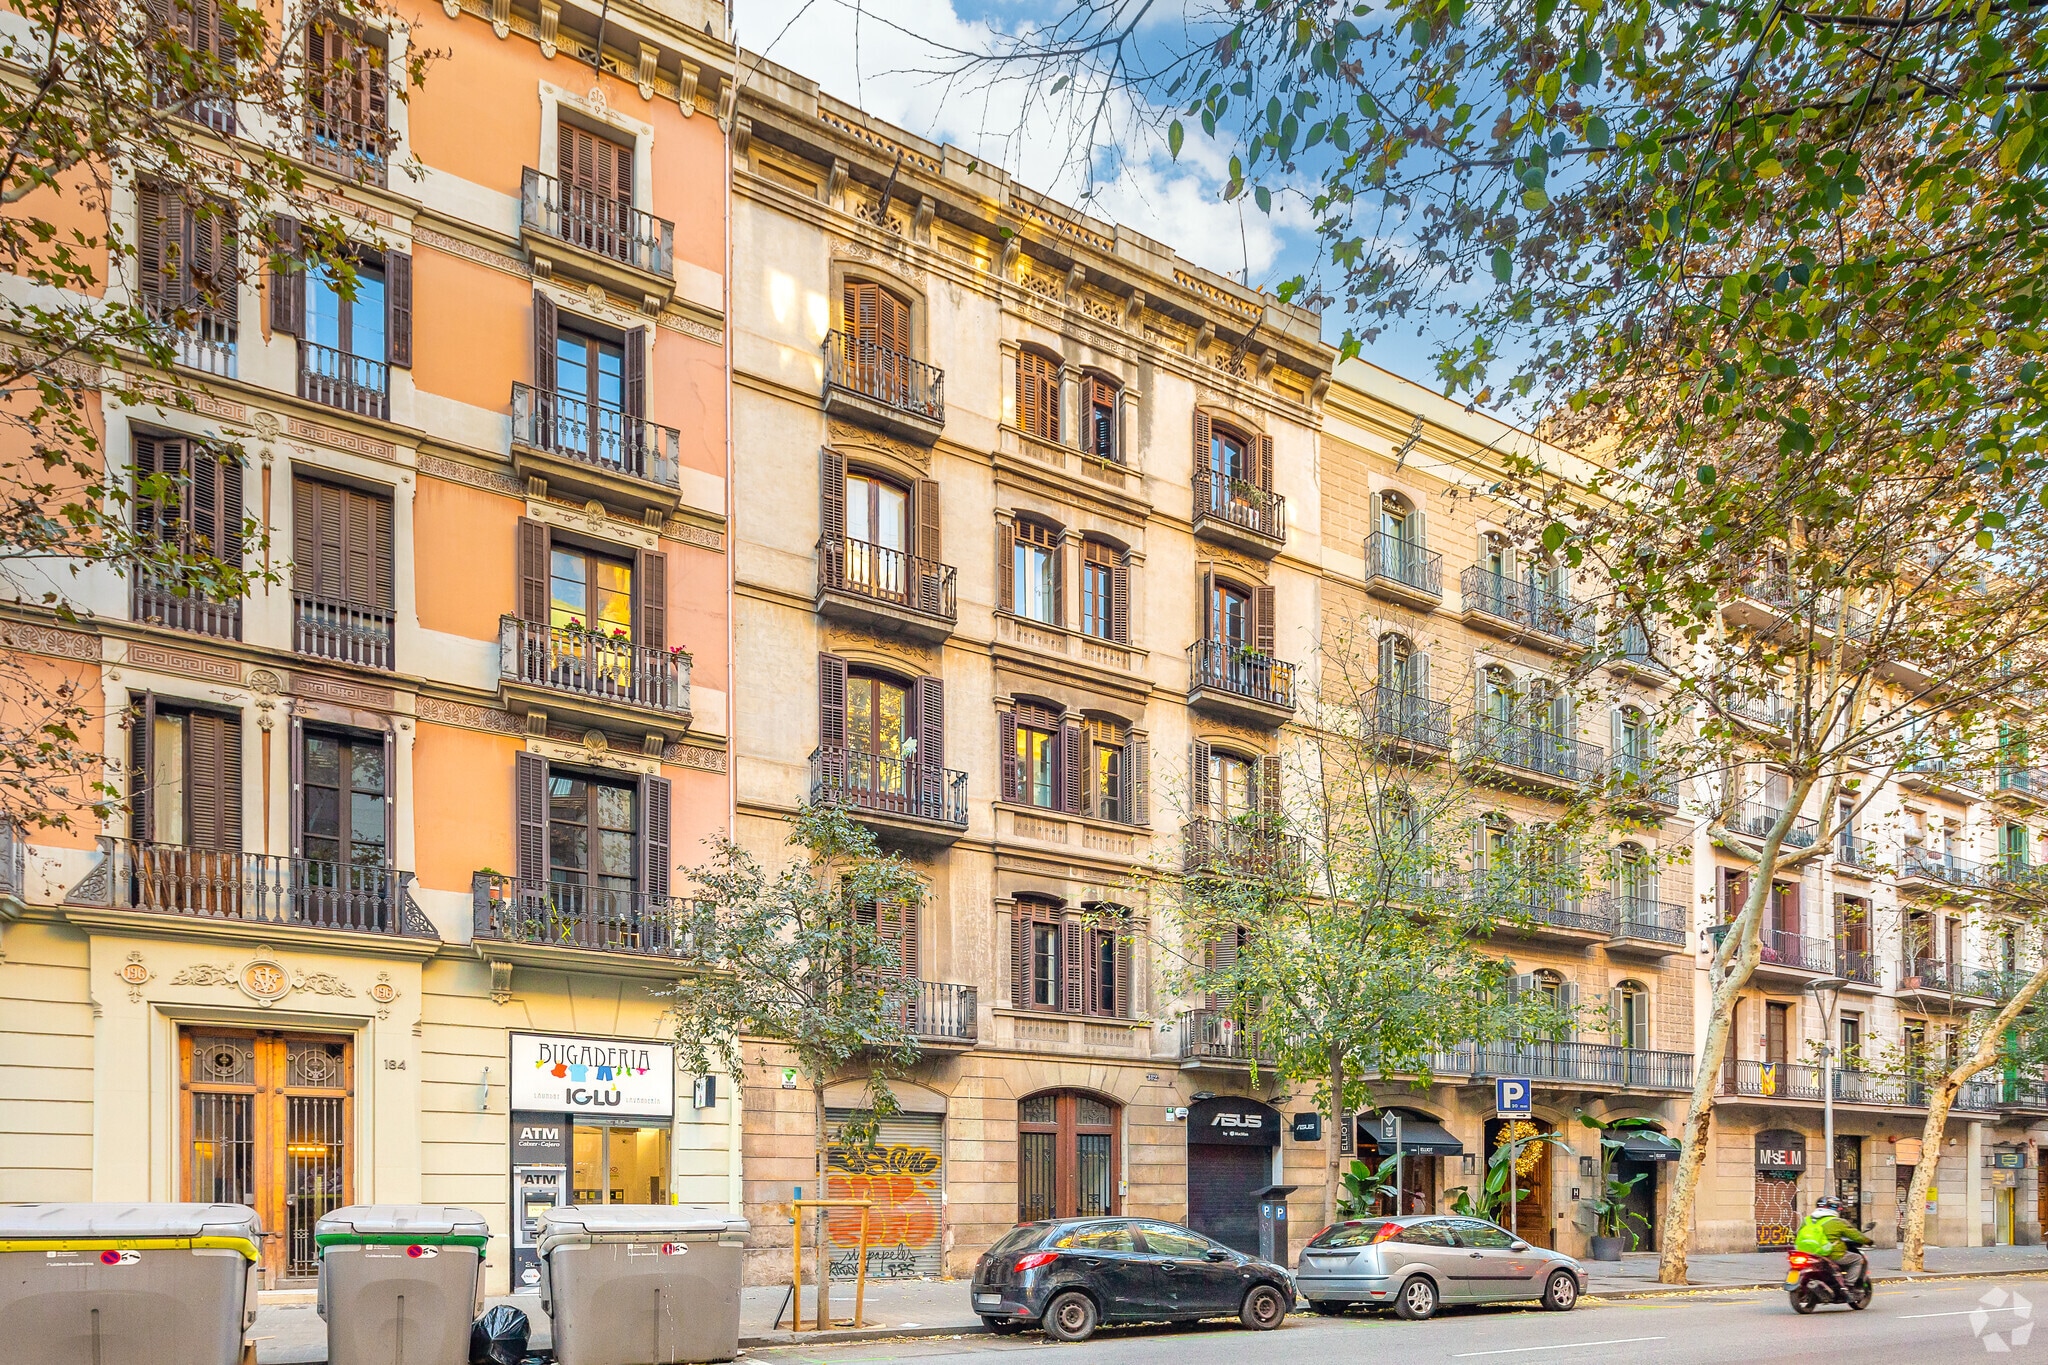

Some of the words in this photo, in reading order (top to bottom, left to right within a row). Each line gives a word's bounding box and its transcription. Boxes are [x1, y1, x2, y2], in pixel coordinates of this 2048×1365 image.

[126, 967, 145, 979] 196
[375, 988, 392, 998] 196
[539, 1043, 650, 1071] BUGADERIA
[384, 1059, 407, 1071] 184
[1503, 1082, 1525, 1109] P
[1210, 1112, 1262, 1128] ASUS
[1296, 1123, 1315, 1131] ASUS
[520, 1128, 559, 1140] ATM
[1341, 1121, 1349, 1151] ELLIOT
[524, 1174, 557, 1184] ATM
